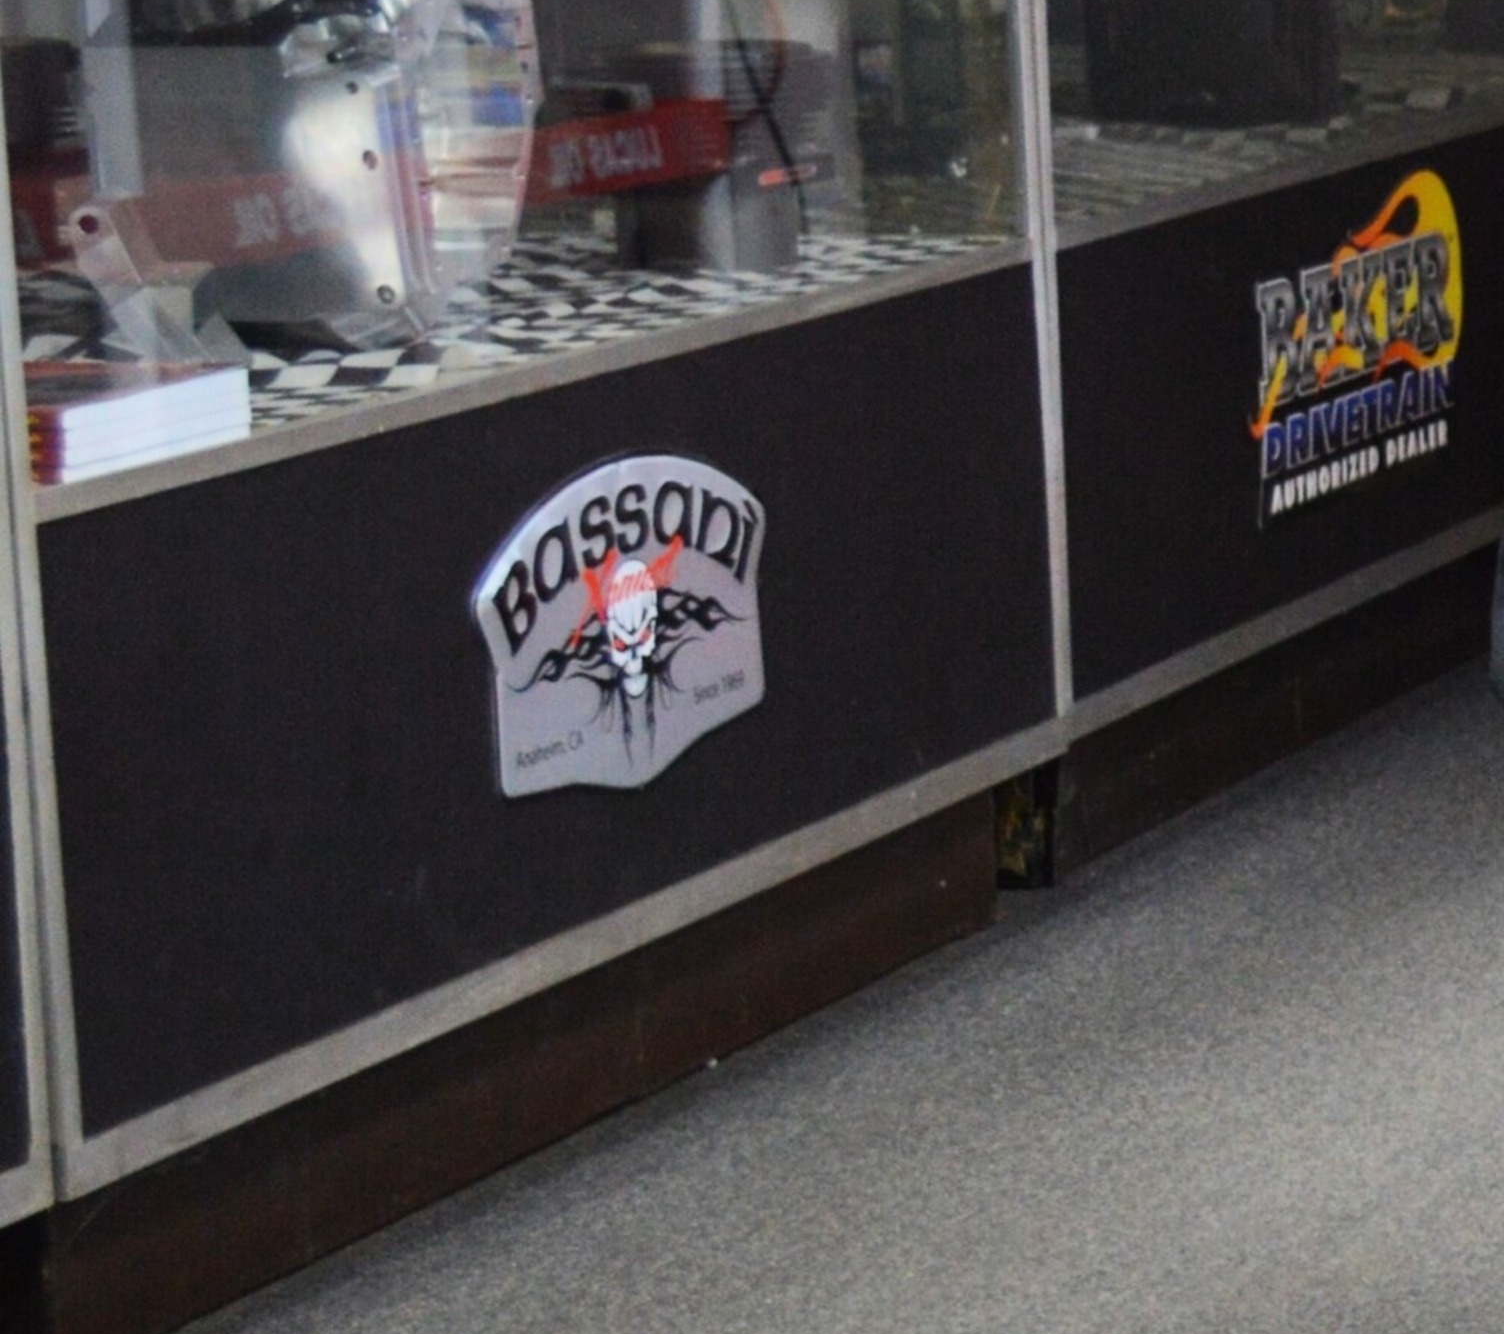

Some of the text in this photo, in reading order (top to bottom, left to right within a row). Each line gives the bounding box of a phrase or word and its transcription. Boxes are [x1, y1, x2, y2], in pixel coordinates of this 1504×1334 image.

[1256, 231, 1455, 409] BAKER
[1260, 359, 1455, 479] DRIVETRAIN
[1270, 419, 1449, 515] AUTHORIZED DEALER
